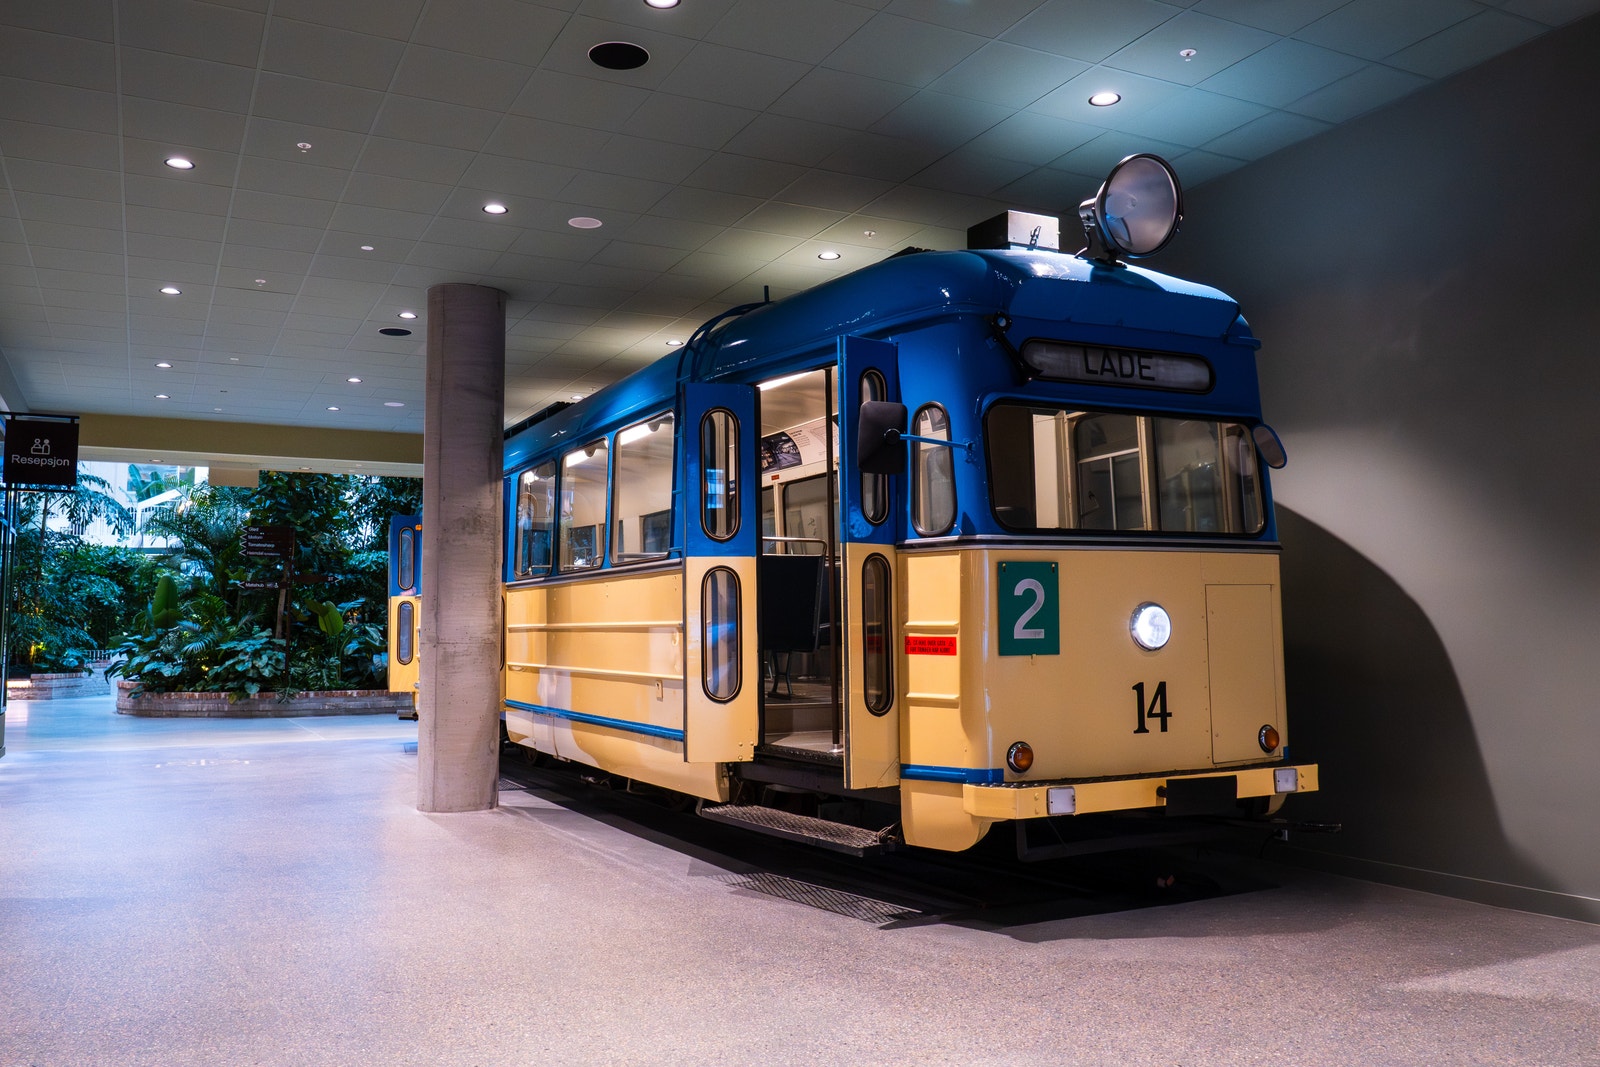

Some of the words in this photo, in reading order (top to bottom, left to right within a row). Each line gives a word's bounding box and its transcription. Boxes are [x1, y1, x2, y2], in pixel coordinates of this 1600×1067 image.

[1083, 347, 1155, 381] LADE
[11, 454, 70, 468] Resepsjon
[1013, 578, 1045, 639] 2
[1131, 681, 1173, 734] 14
